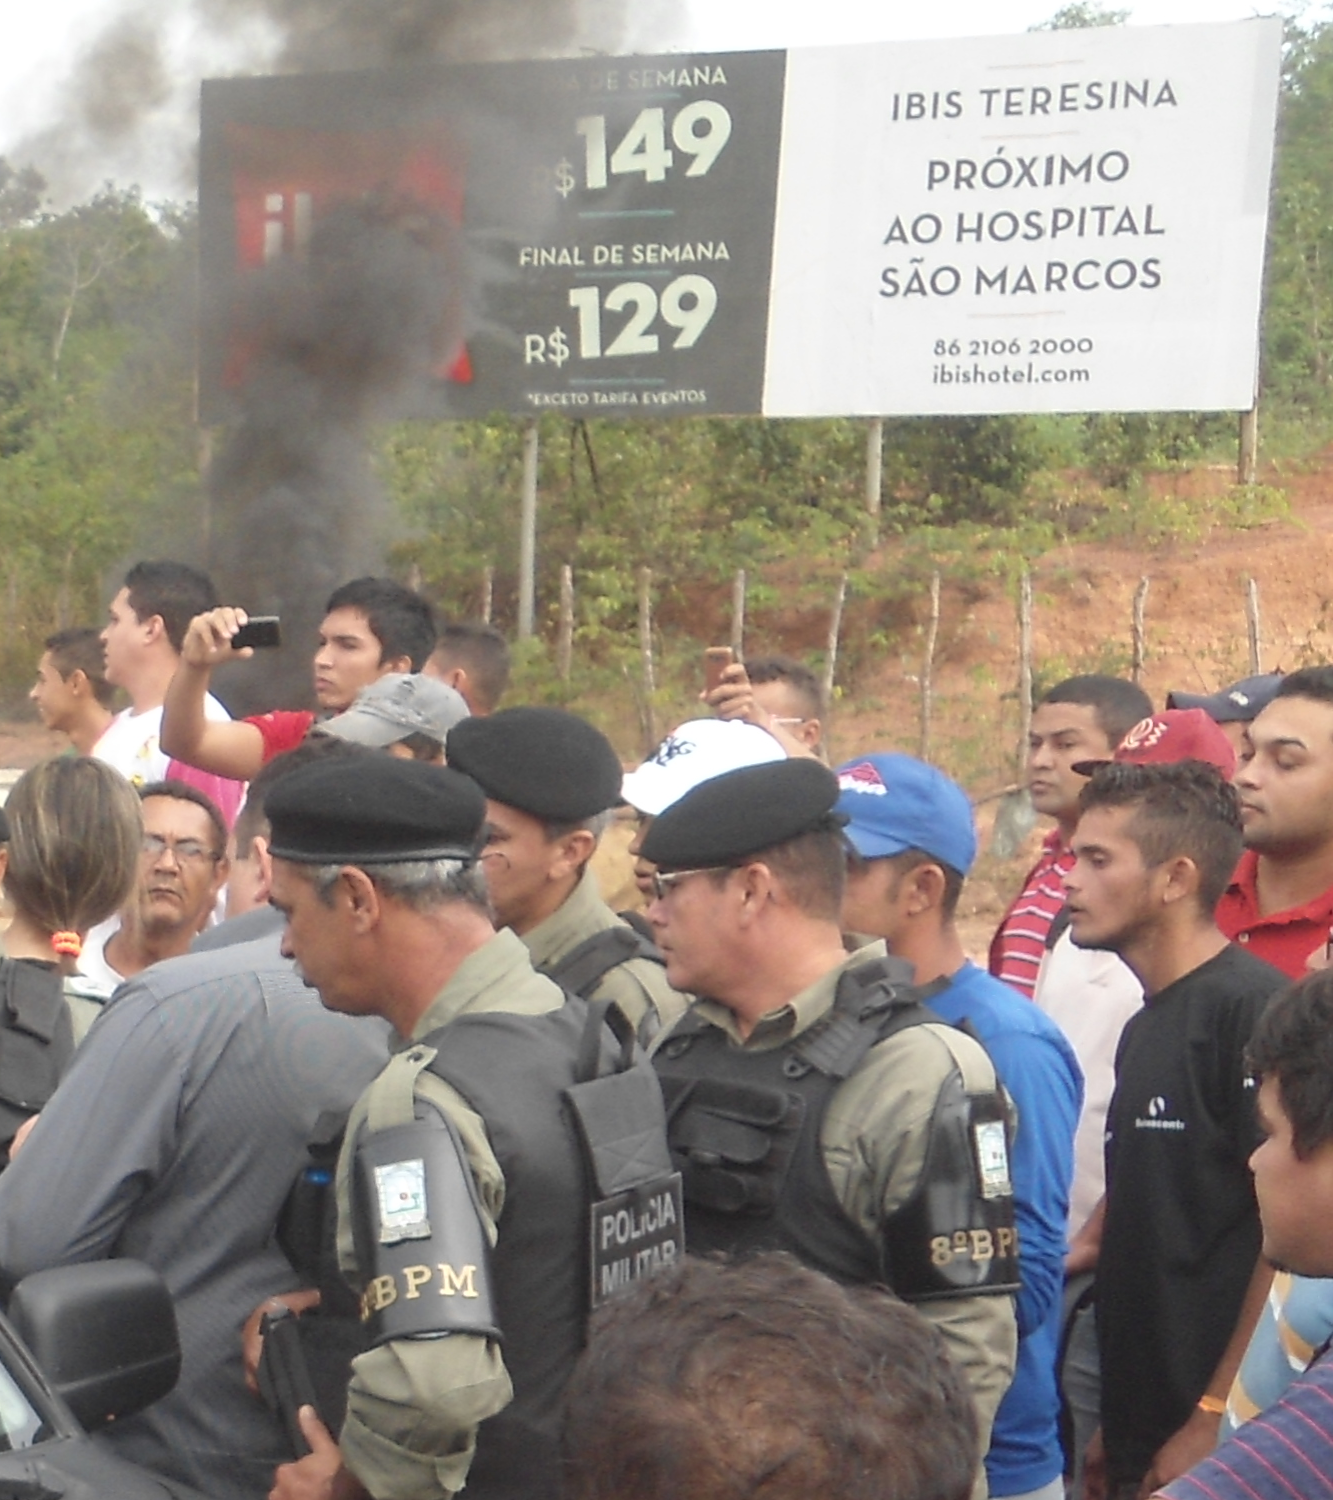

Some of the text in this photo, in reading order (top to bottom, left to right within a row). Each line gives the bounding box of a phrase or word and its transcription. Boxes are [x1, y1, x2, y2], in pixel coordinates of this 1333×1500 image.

[628, 65, 728, 90] SEMANA
[890, 78, 1179, 122] IBIS TERESINA
[926, 145, 1131, 191] PRÓXIMO
[882, 203, 1166, 246] AO HOSPITAL
[519, 241, 731, 267] FINAL DE SEMANA
[878, 256, 1162, 299] SÃO MARCOS
[933, 336, 1094, 357] 86 2106 2000
[932, 362, 1091, 385] ibishotel.com
[592, 390, 639, 405] TARIFA
[642, 388, 707, 405] EVENTOS
